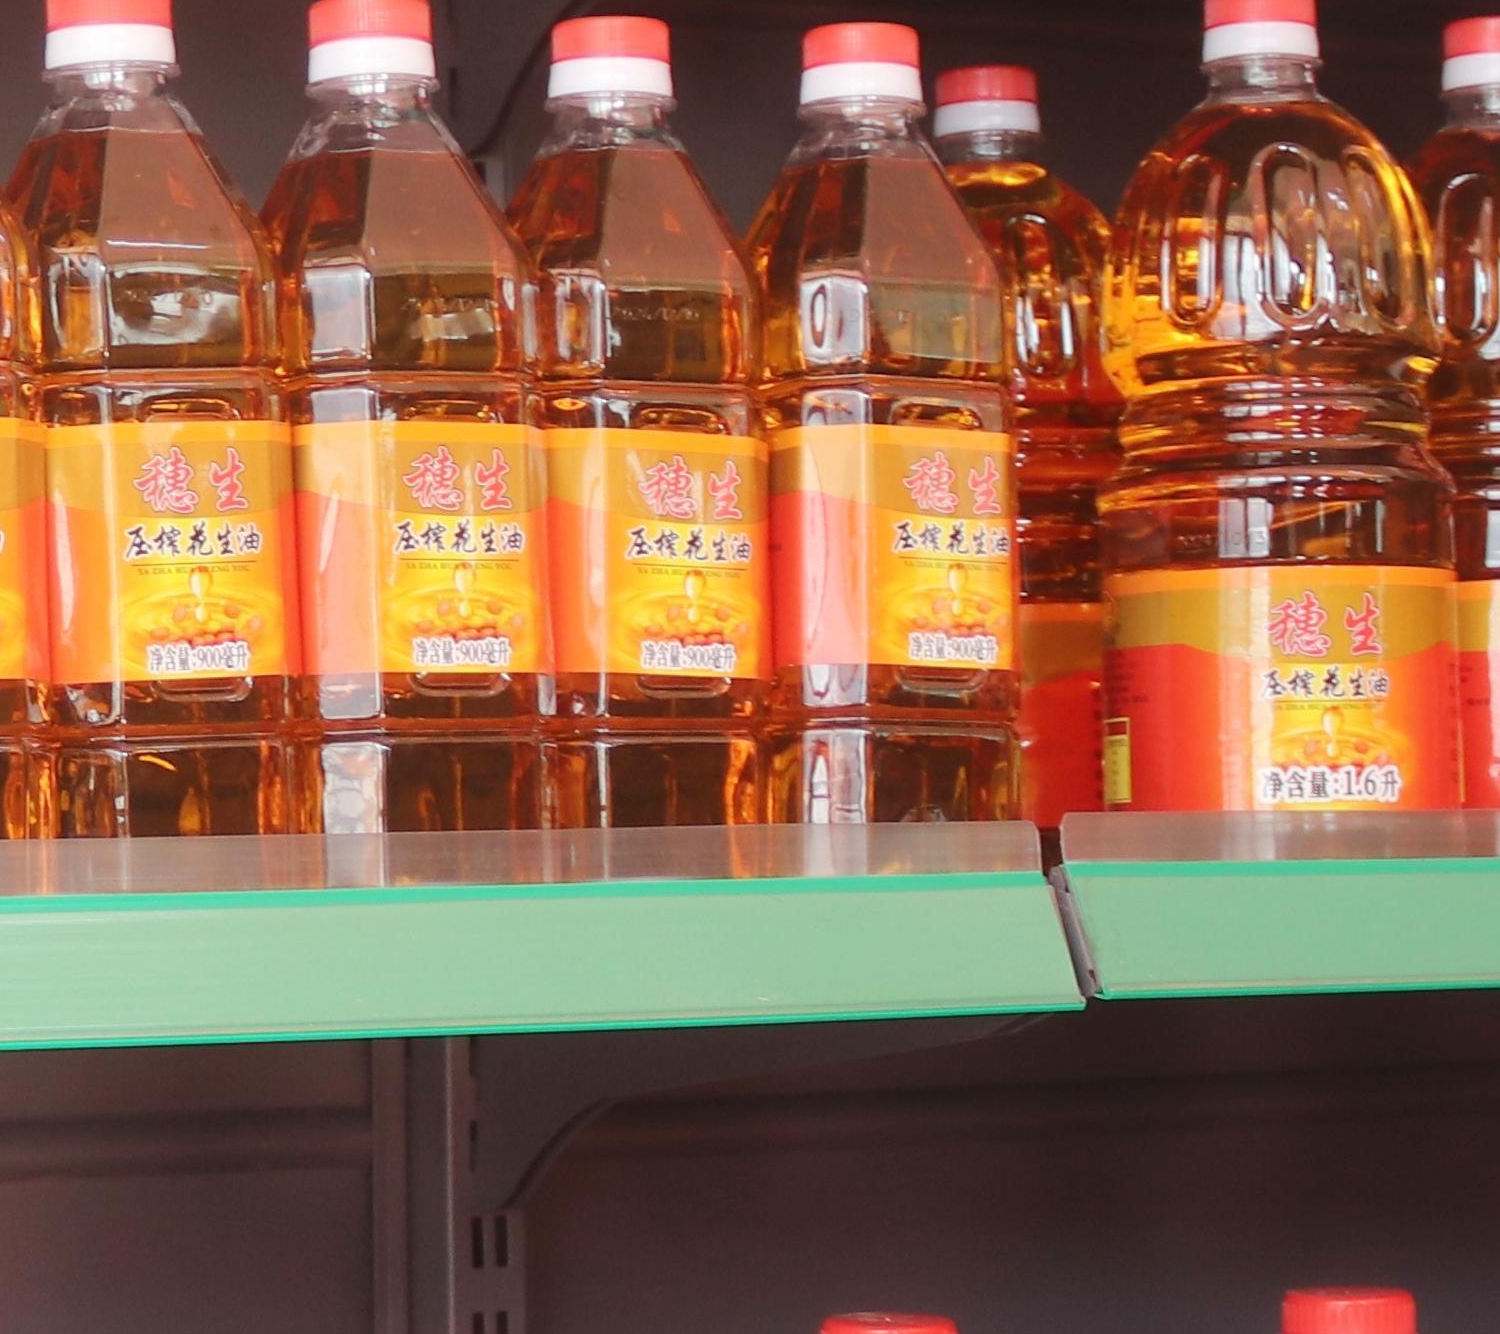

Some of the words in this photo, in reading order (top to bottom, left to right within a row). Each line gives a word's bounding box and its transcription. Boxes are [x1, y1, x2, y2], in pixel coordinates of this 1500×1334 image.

[134, 447, 248, 513] 穗生
[401, 445, 513, 511] 穗生
[638, 454, 744, 521] 穗生
[902, 451, 1002, 515] 穗生
[123, 519, 262, 559] 压榨花生油
[393, 517, 526, 556] 压榨花生油
[625, 526, 753, 563] 压榨花生油
[892, 520, 1010, 556] 压榨花生油
[1268, 591, 1383, 658] 穗生
[1259, 670, 1389, 700] 压榨花生油
